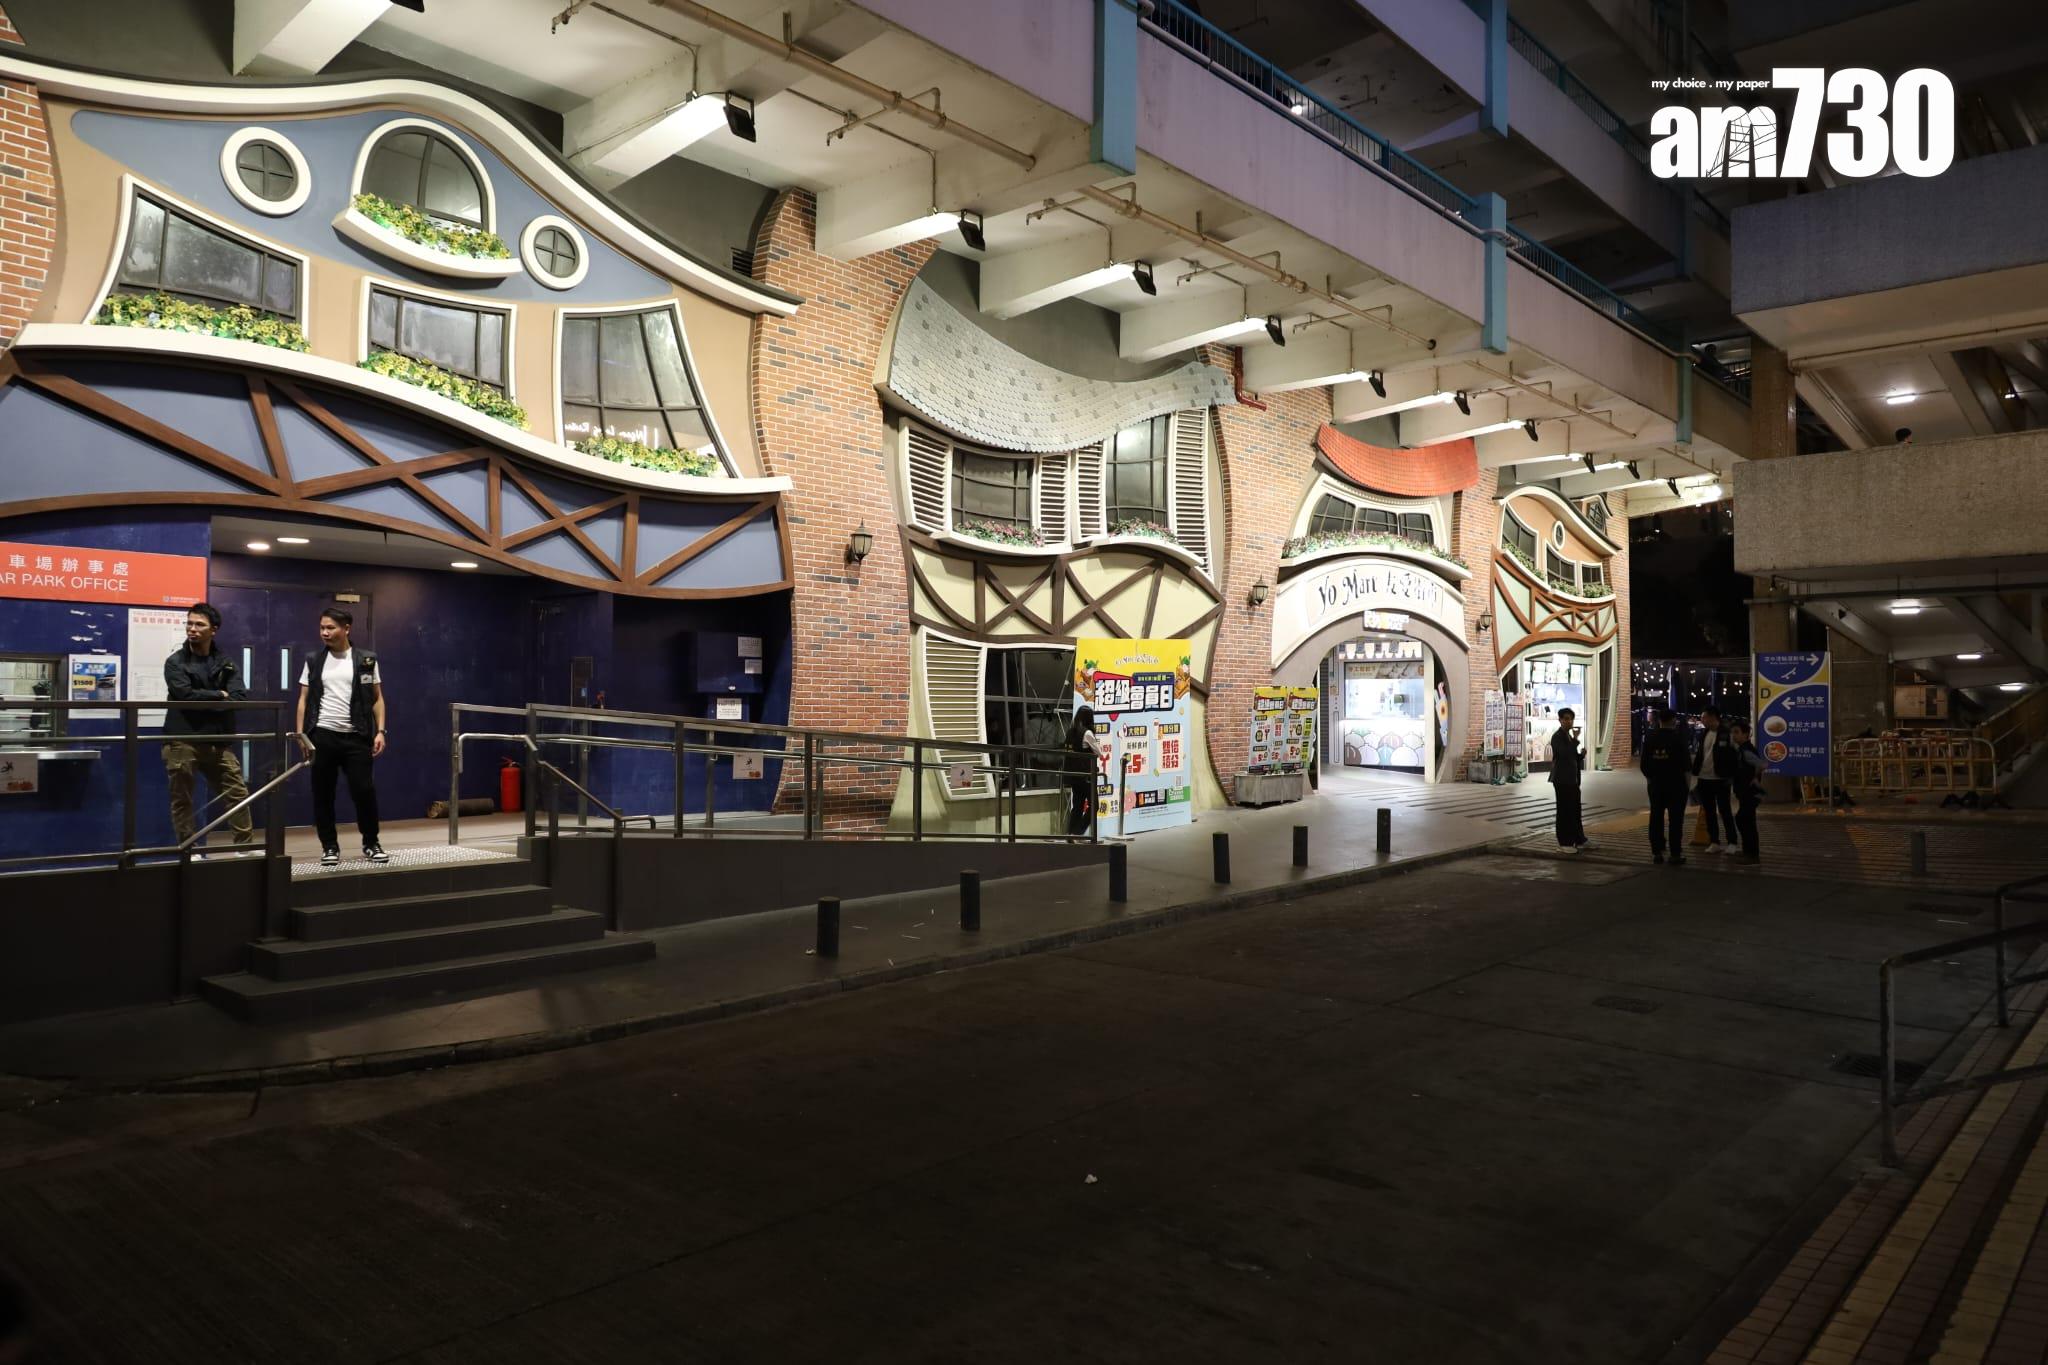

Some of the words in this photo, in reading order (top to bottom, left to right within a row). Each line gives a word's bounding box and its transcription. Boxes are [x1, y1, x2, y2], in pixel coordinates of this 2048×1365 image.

[9, 554, 129, 576] 車場辦事處
[22, 574, 66, 588] PARK
[71, 576, 129, 592] OFFICE
[74, 663, 83, 673] P
[1095, 679, 1172, 712] 超級會員日
[1760, 688, 1771, 699] D
